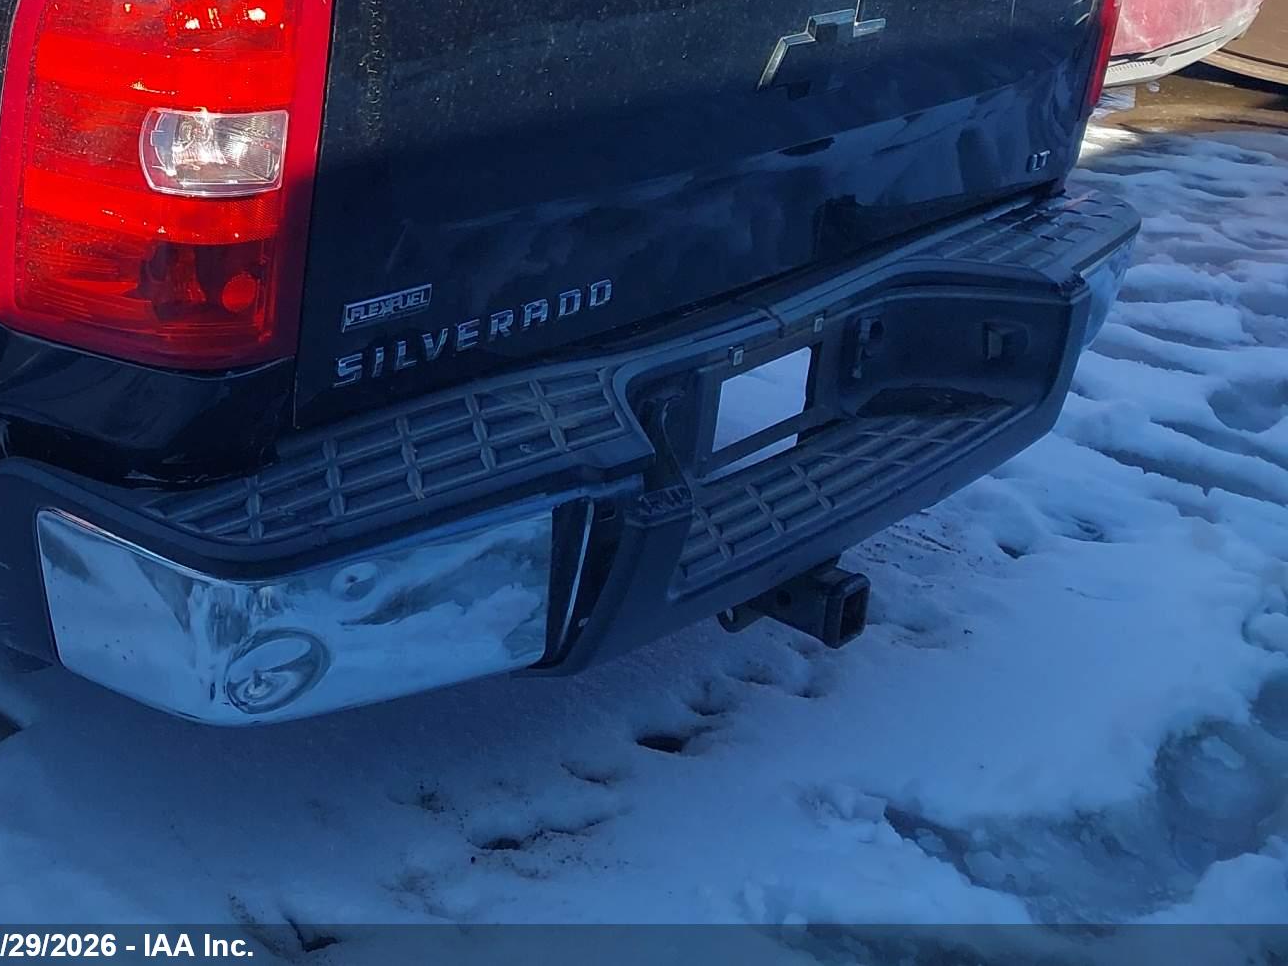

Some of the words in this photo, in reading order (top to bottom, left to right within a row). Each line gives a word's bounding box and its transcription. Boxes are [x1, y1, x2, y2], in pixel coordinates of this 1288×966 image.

[1028, 149, 1051, 171] LT
[348, 288, 430, 324] FLEXFUEL
[333, 278, 612, 387] SILVERADO
